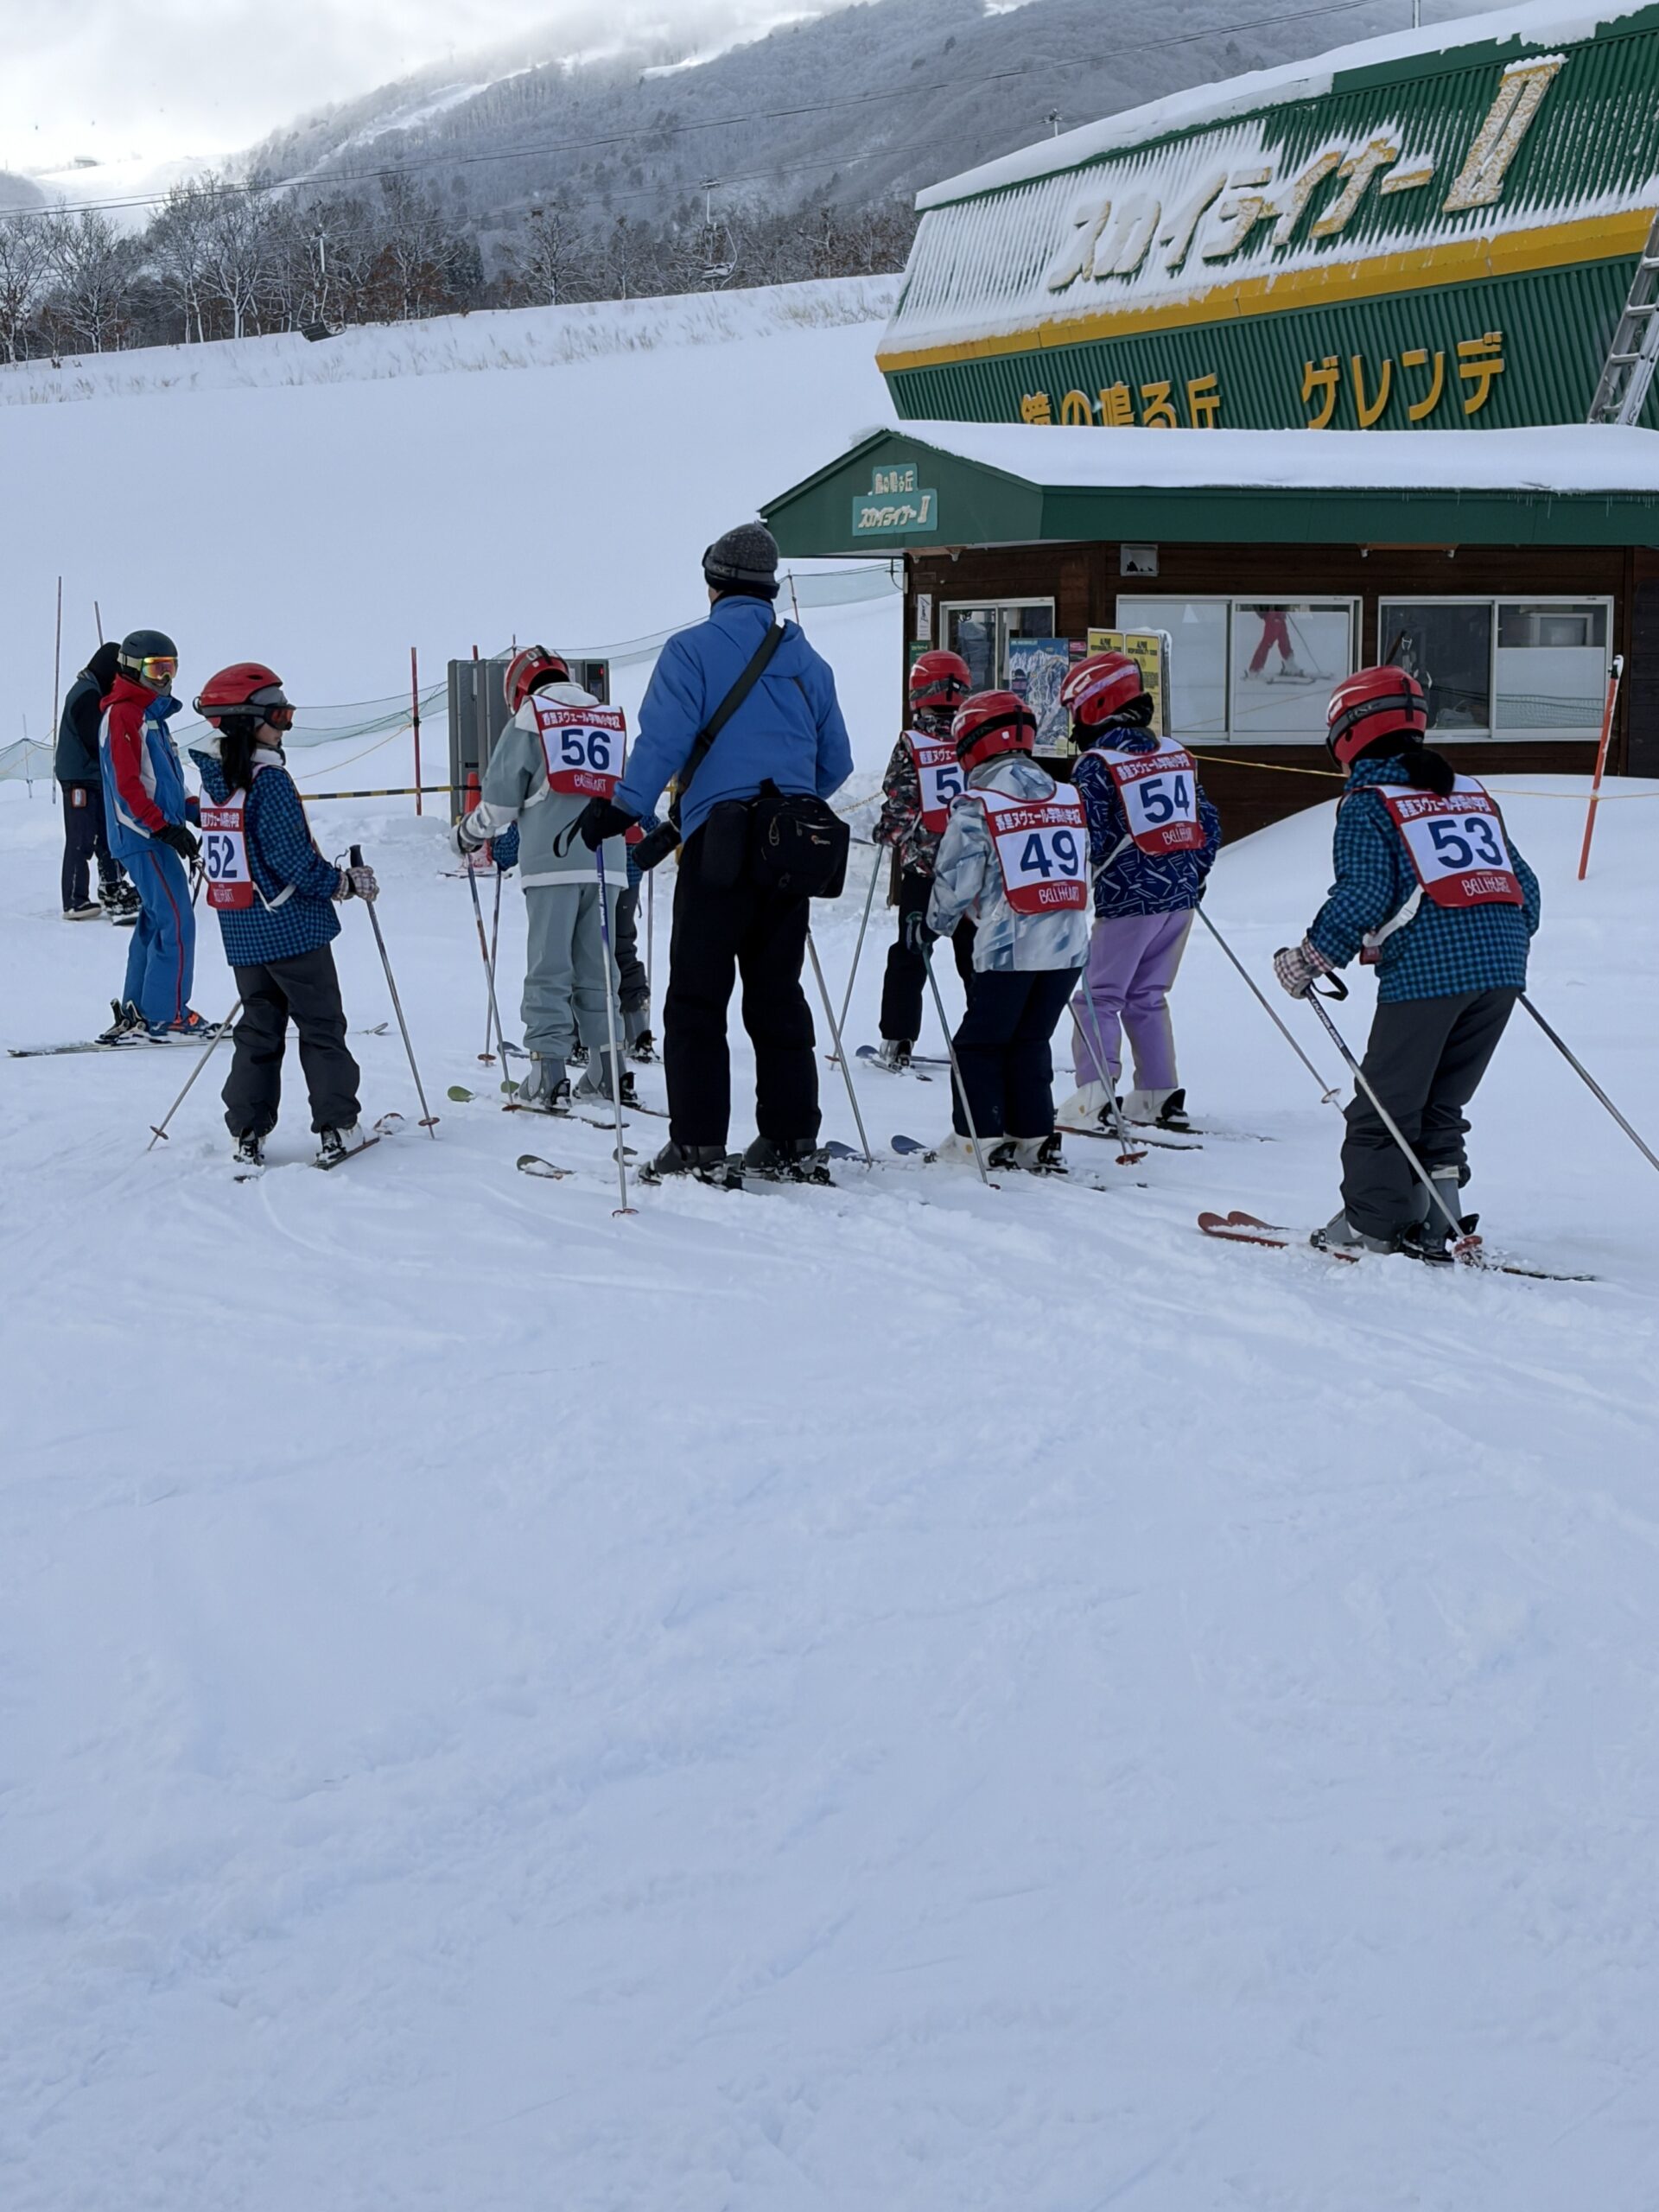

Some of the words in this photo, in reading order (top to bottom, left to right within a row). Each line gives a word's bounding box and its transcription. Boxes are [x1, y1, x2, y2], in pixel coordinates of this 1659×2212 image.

[1302, 332, 1505, 429] ゲレンデ
[561, 728, 611, 771] 56
[936, 766, 968, 804] 5
[1139, 774, 1190, 823] 54
[207, 835, 238, 879] 52
[1020, 830, 1079, 878] 49
[1427, 817, 1503, 868] 53
